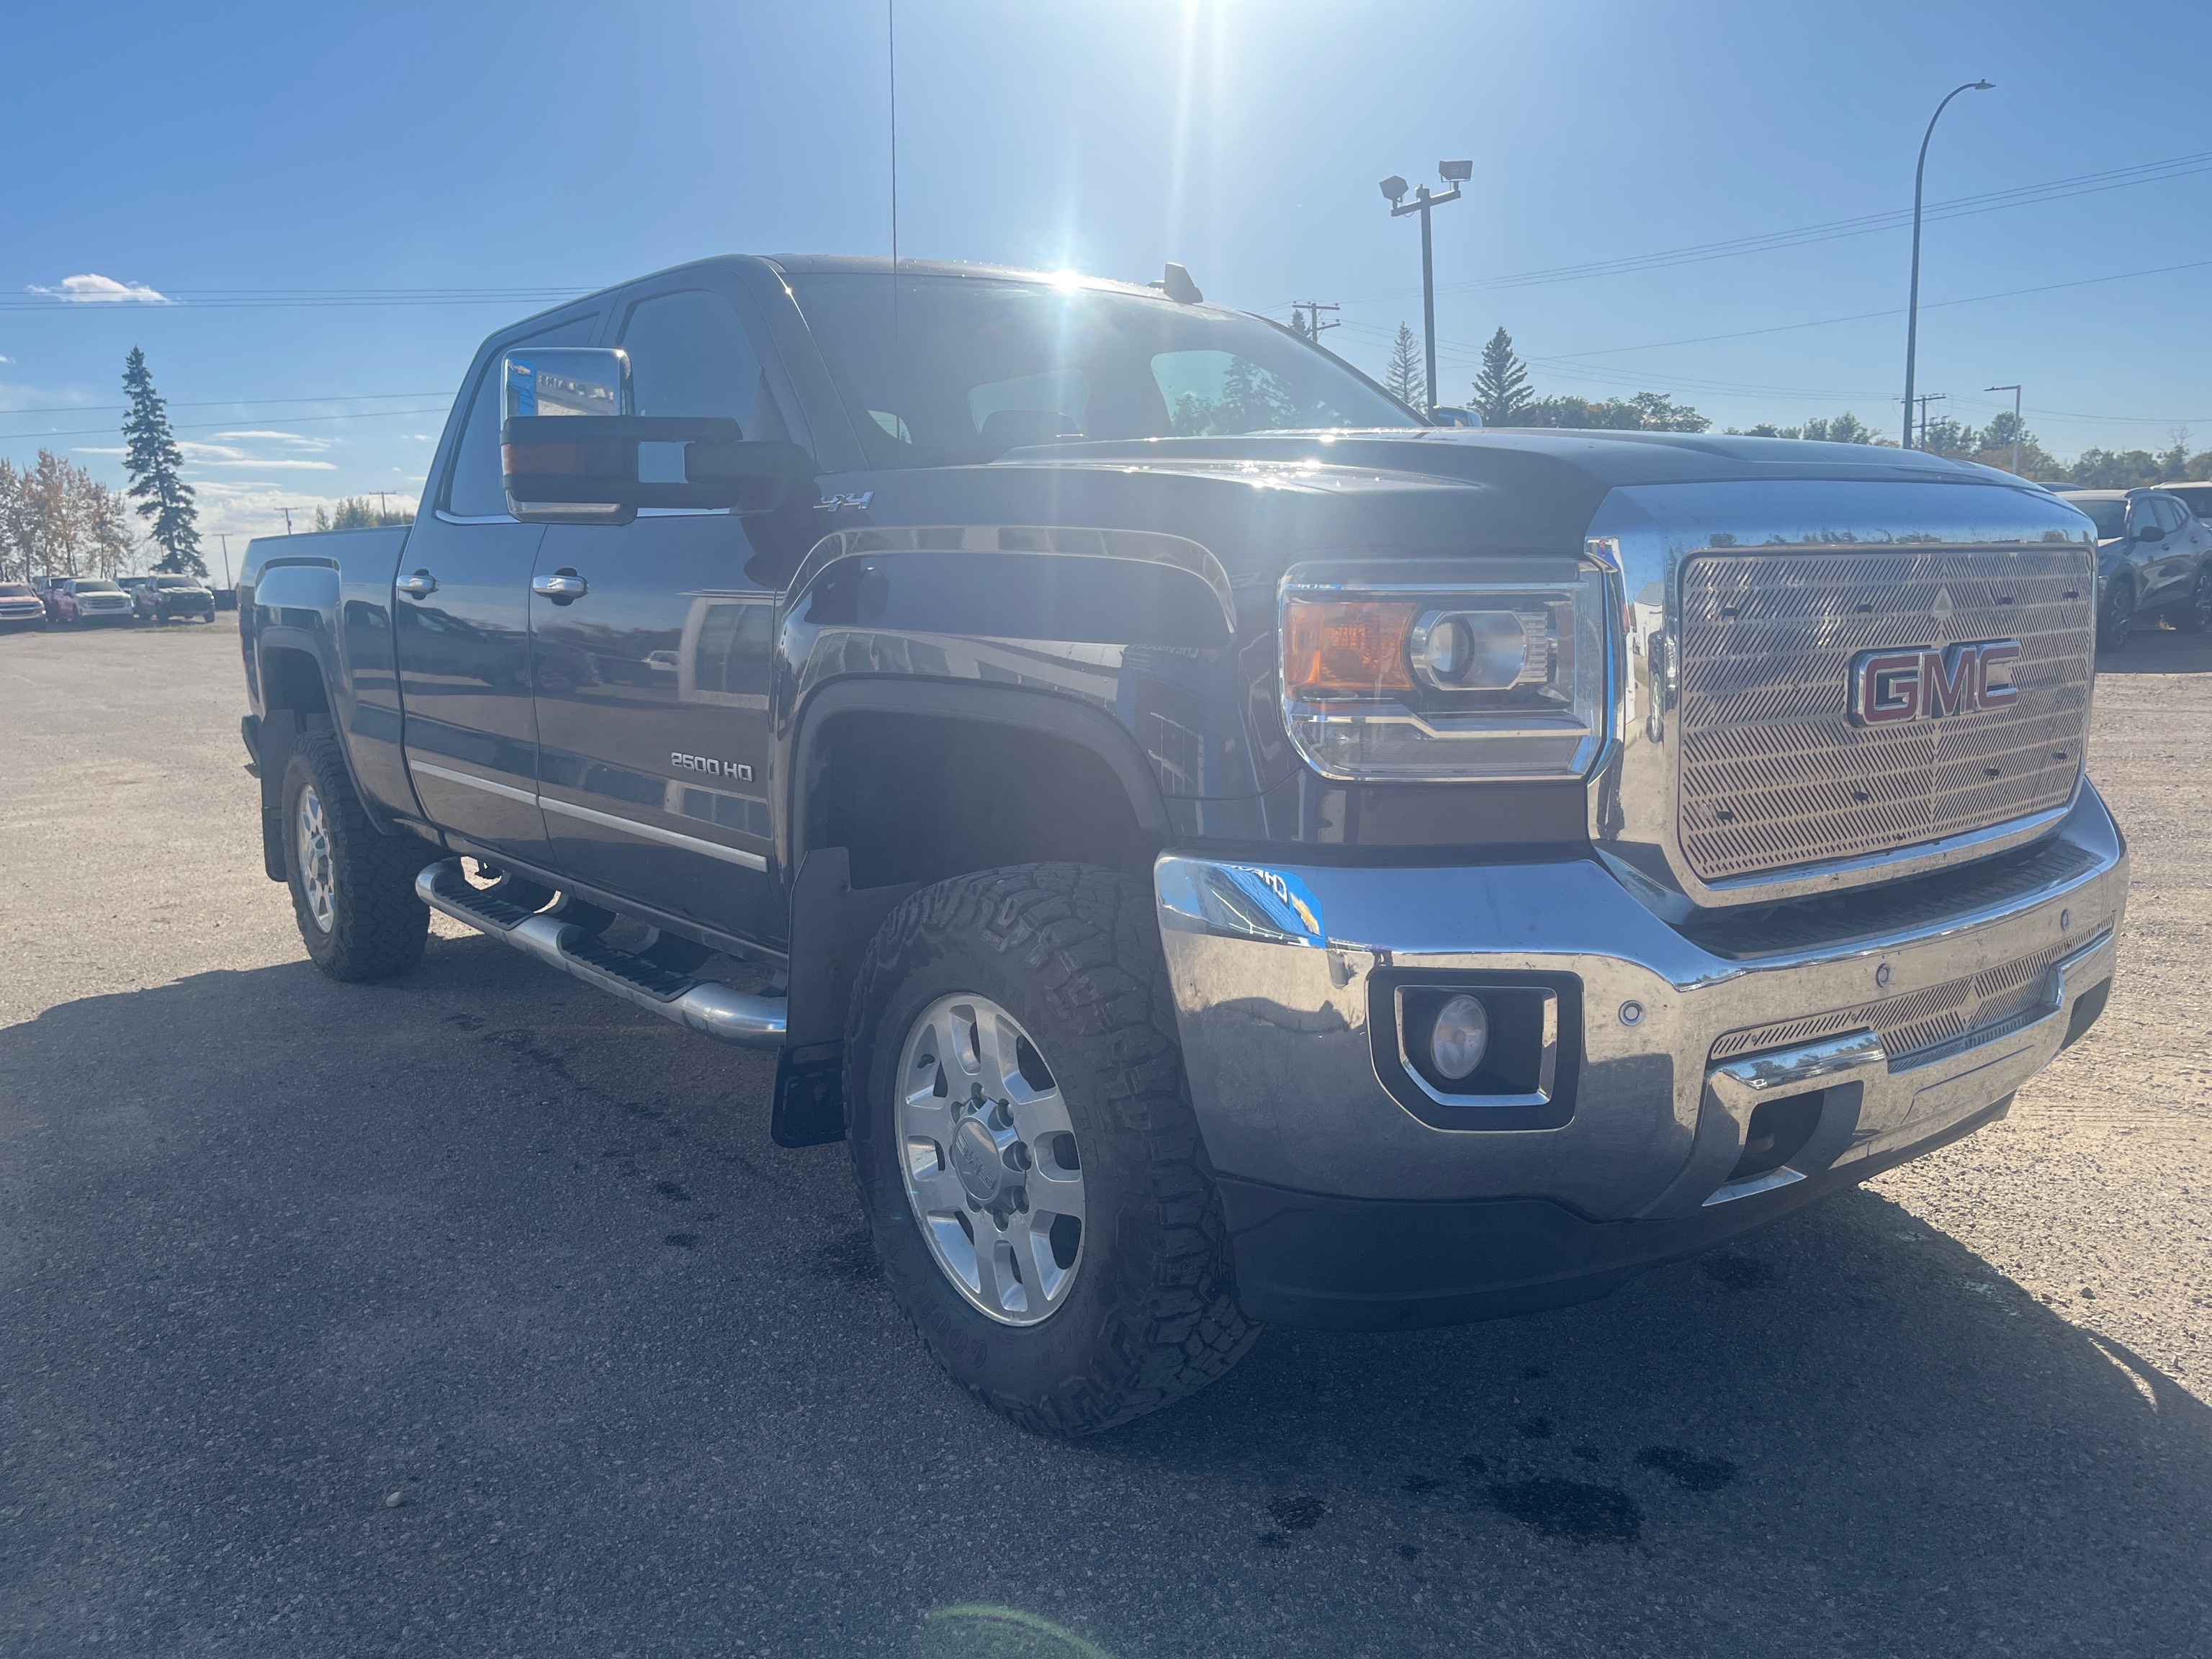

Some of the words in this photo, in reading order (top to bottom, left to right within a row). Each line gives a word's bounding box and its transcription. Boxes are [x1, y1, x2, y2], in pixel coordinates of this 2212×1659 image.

[1847, 639, 2020, 728] GMC
[670, 752, 721, 776] 2500
[724, 761, 754, 783] HD
[954, 1132, 995, 1189] GMC
